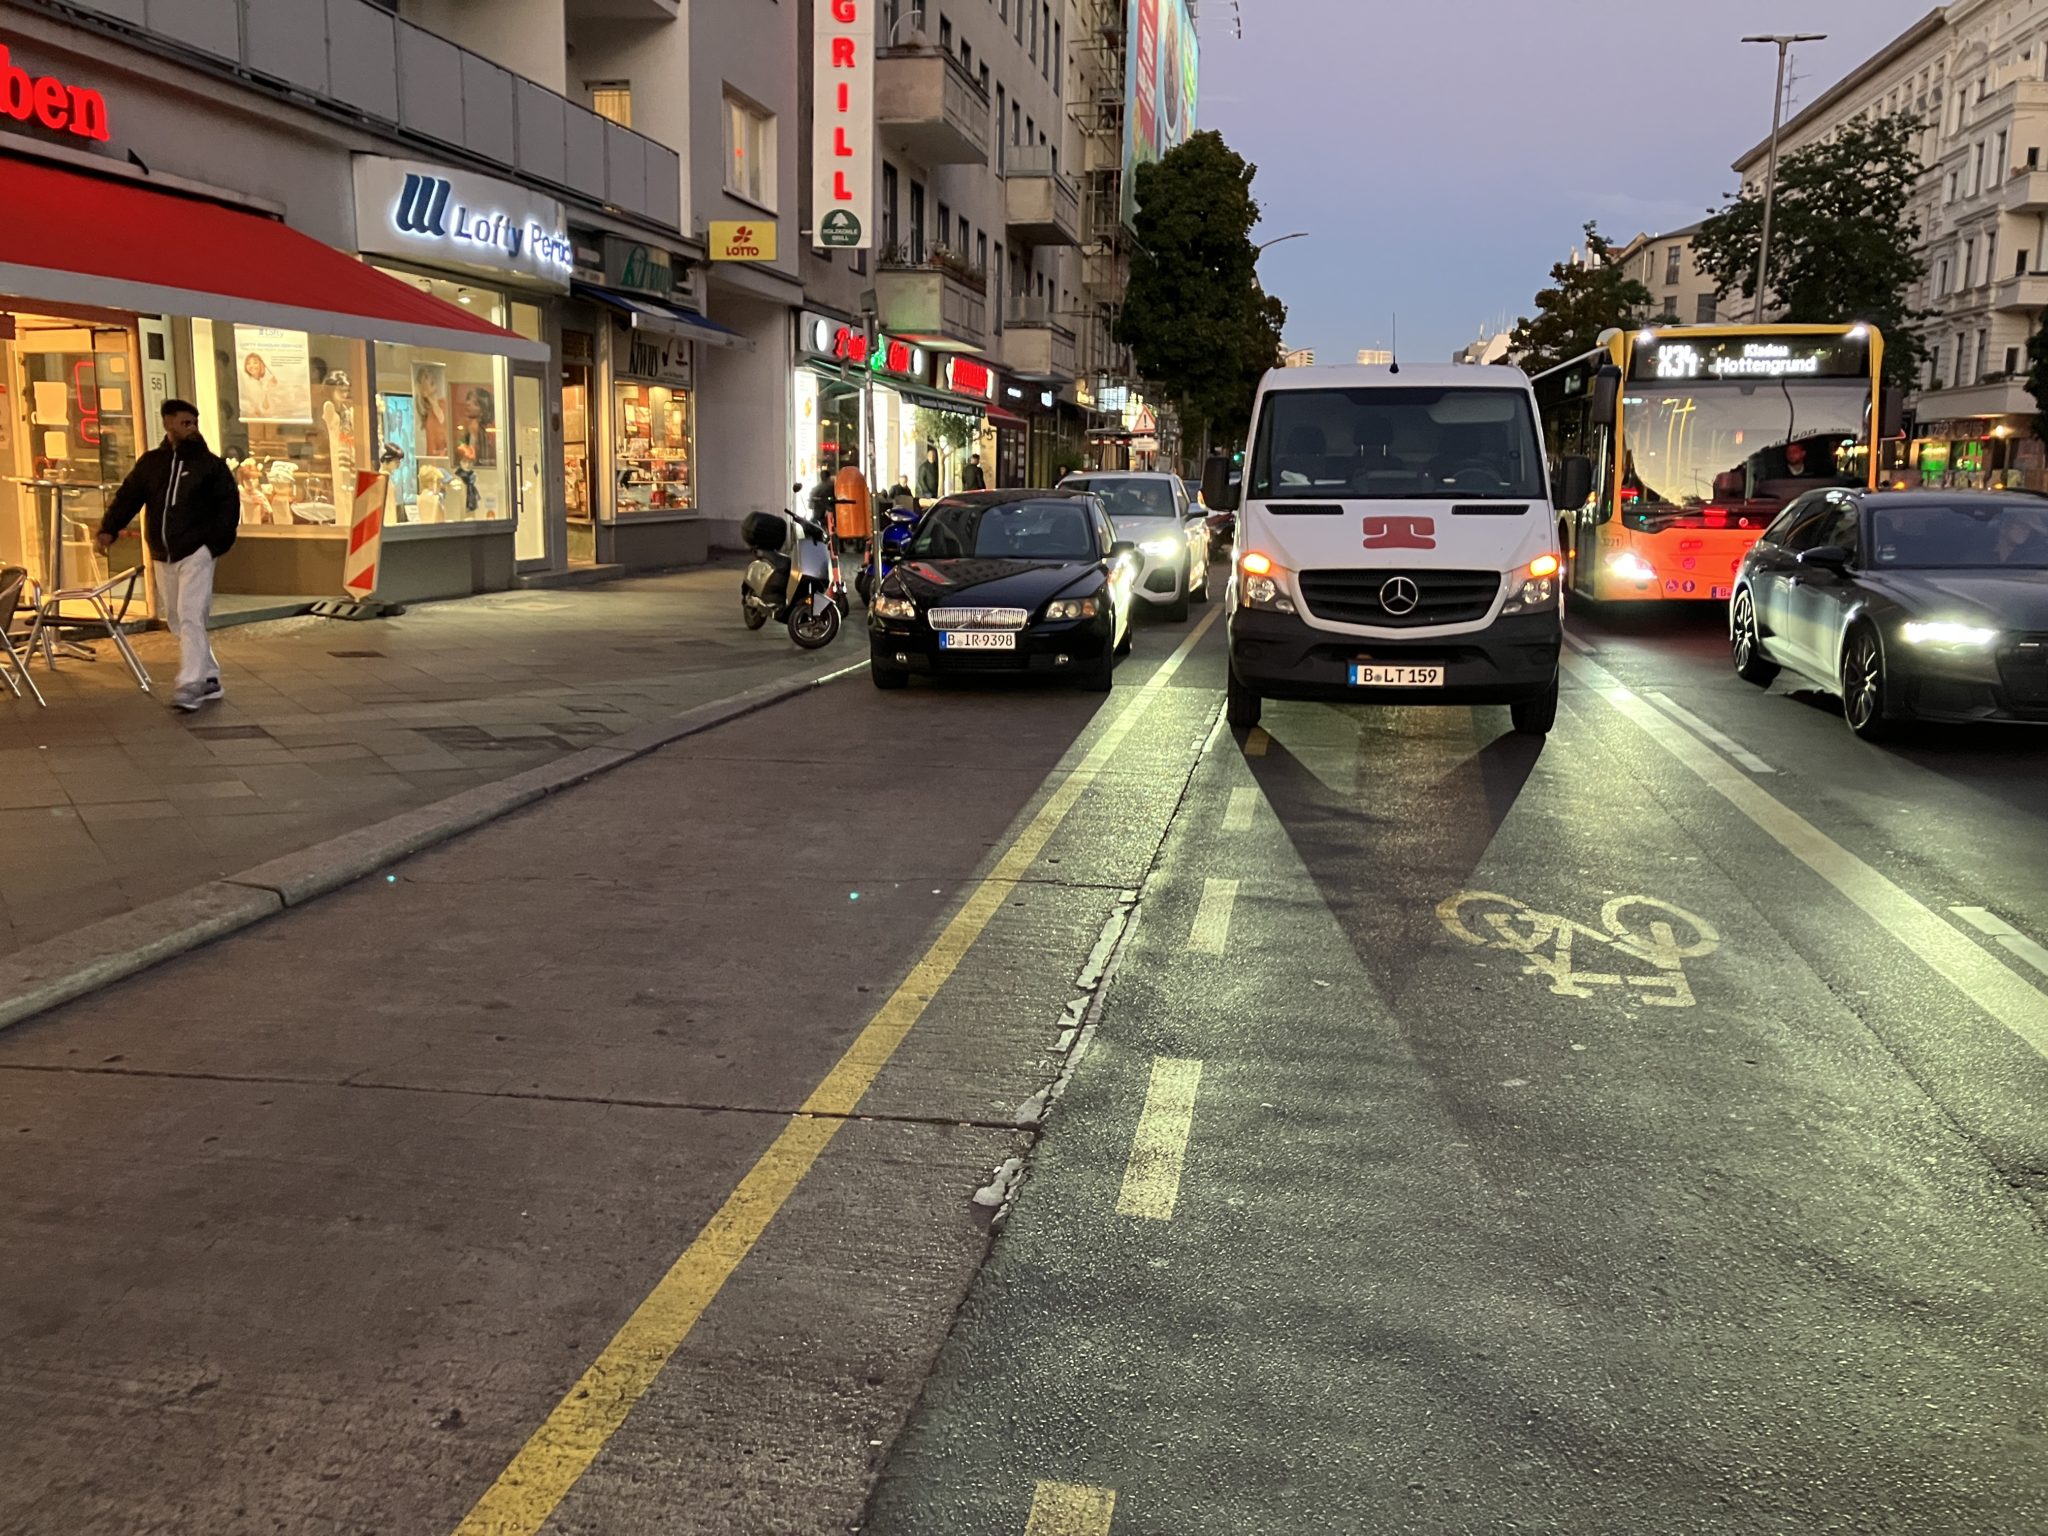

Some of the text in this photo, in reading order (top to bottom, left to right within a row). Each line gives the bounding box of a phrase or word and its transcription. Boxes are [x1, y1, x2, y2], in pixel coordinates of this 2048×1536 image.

[831, 0, 857, 201] GRILL
[453, 207, 524, 258] Lofty
[726, 246, 760, 257] LOTTO
[1715, 355, 1818, 376] Hottengrund
[151, 377, 163, 391] 56
